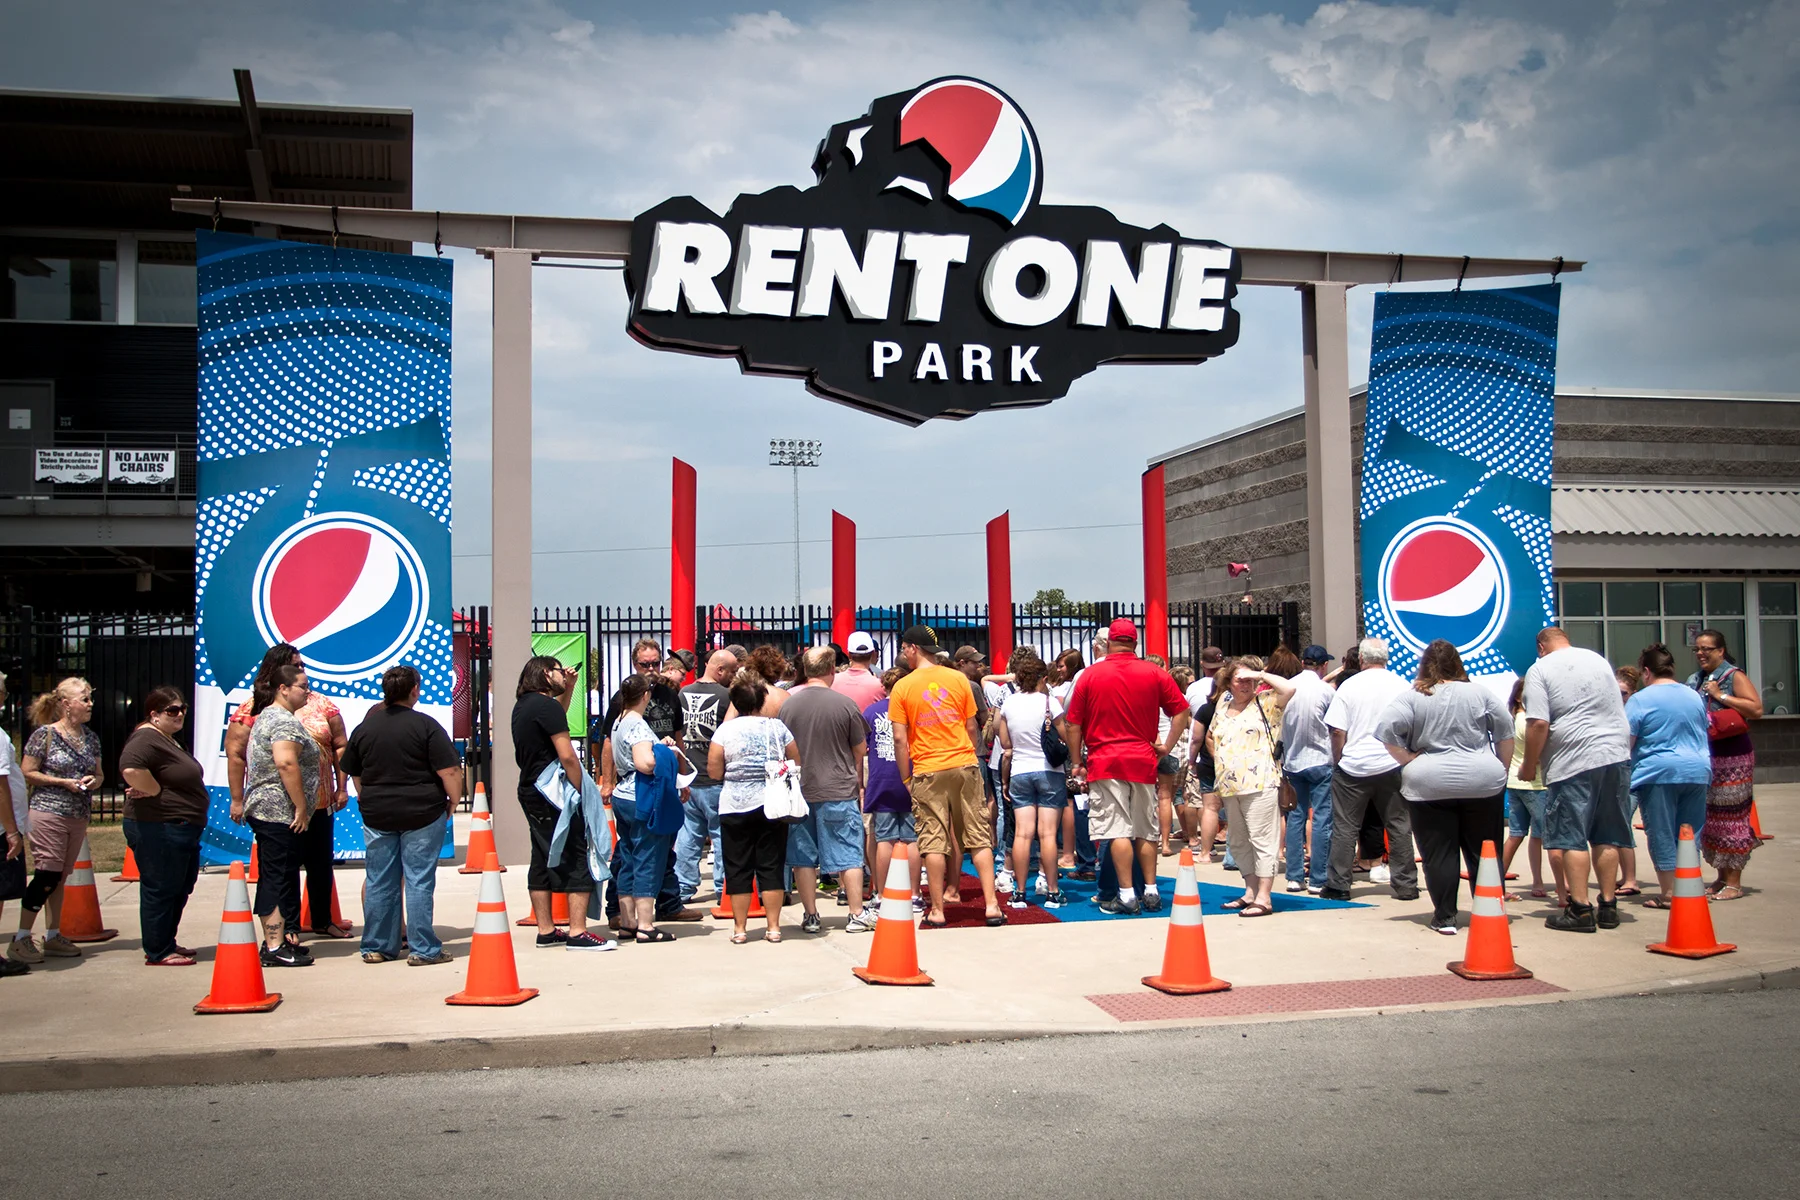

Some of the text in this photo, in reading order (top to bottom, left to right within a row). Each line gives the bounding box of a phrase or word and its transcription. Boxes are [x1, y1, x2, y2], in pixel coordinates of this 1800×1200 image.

[640, 221, 1233, 331] RENT ONE
[872, 339, 1043, 383] PARK
[115, 452, 169, 463] NO LAWN
[119, 462, 165, 473] CHAIRS
